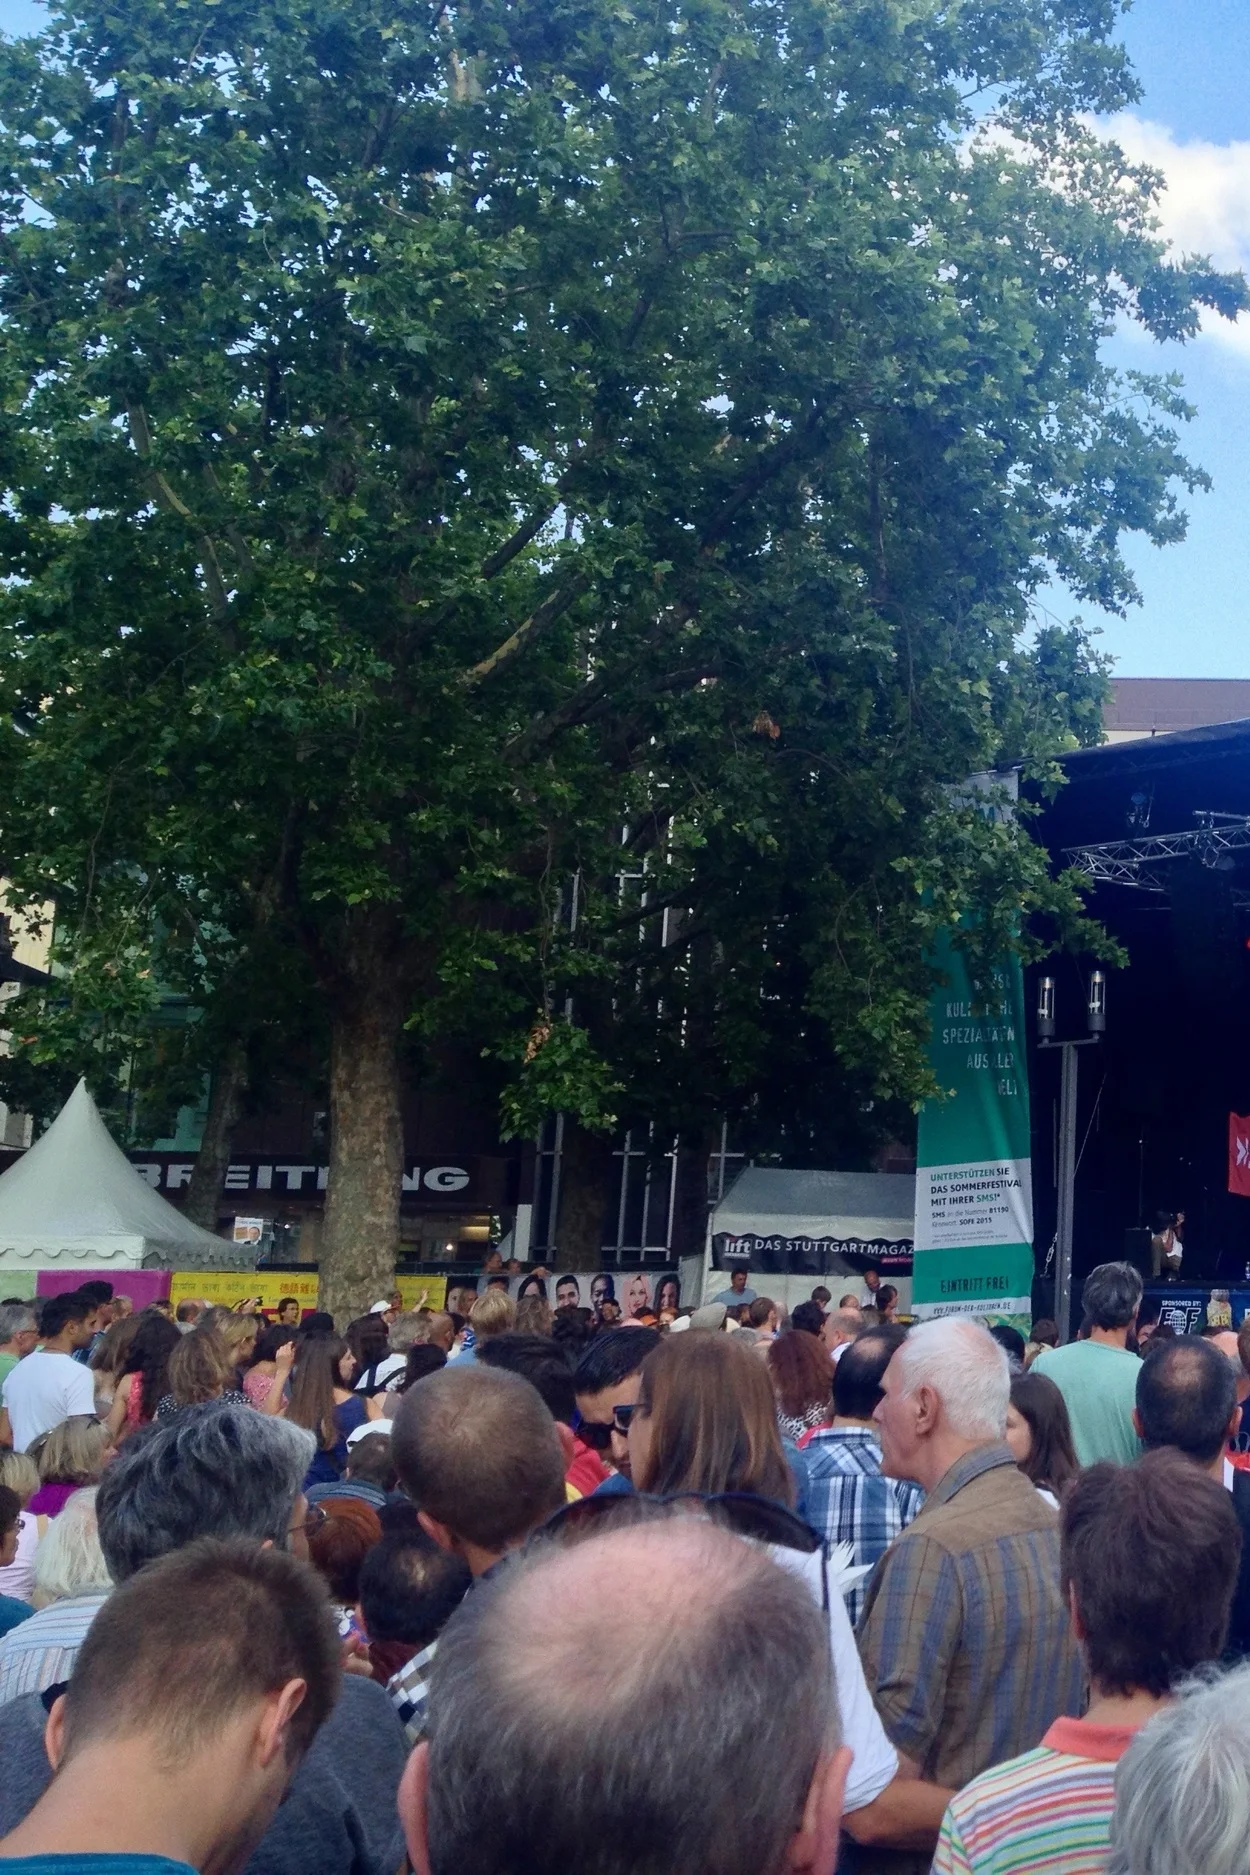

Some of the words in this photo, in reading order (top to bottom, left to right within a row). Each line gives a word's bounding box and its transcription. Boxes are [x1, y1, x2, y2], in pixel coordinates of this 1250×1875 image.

[967, 1054, 988, 1069] AUS
[133, 1164, 470, 1192] BREITNG
[930, 1168, 995, 1181] UNTERSTÜTZEN
[996, 1167, 1010, 1176] SIE
[930, 1185, 948, 1194] DAS
[931, 1198, 947, 1207] MIT
[949, 1195, 975, 1205] IHRER
[931, 1211, 946, 1219] SMS
[724, 1239, 750, 1253] lift
[754, 1239, 781, 1250] DAS
[941, 1279, 983, 1293] EINTRITT
[986, 1276, 1009, 1290] FREI
